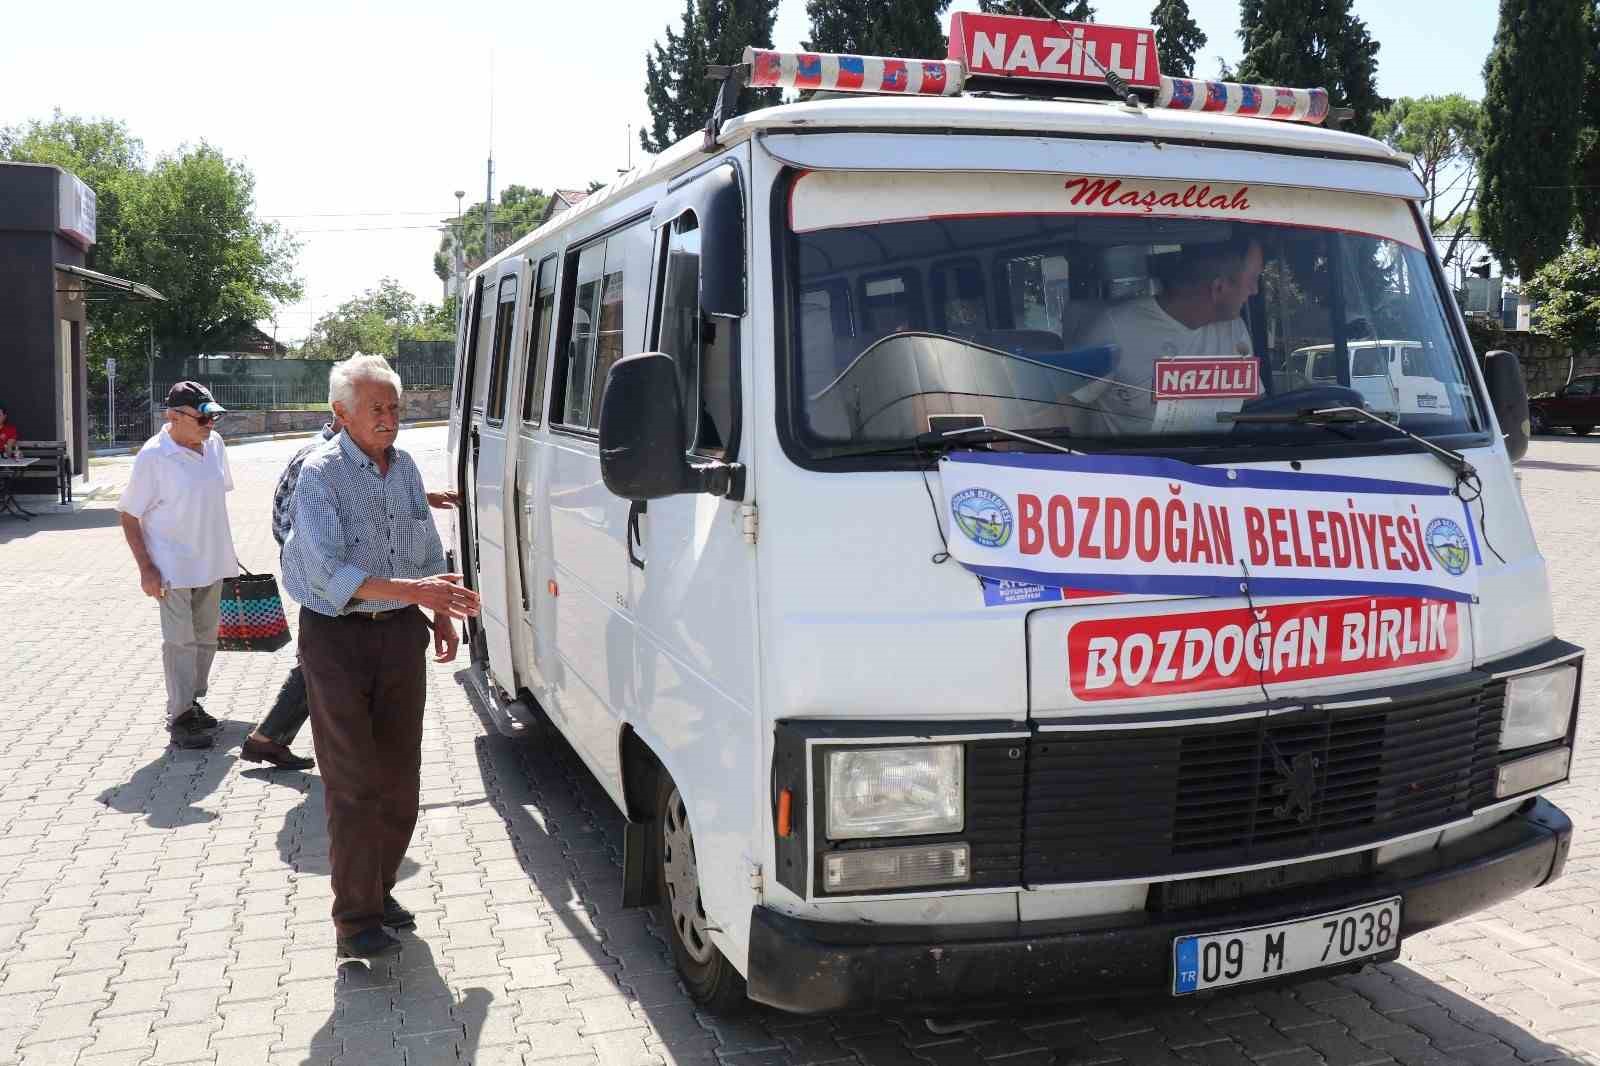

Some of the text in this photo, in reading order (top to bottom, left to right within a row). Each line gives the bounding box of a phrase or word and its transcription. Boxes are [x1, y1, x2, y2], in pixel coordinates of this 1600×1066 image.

[972, 28, 1148, 81] NAZİLLİ
[1064, 177, 1250, 212] Maşallah
[1161, 364, 1252, 392] NAZİLLİ
[1017, 483, 1433, 572] BOZDOĞAN BELEDİYESİ
[1085, 598, 1449, 690] BOZDOĞAN BİRLİK
[1181, 908, 1394, 983] TR 09 M 7038
